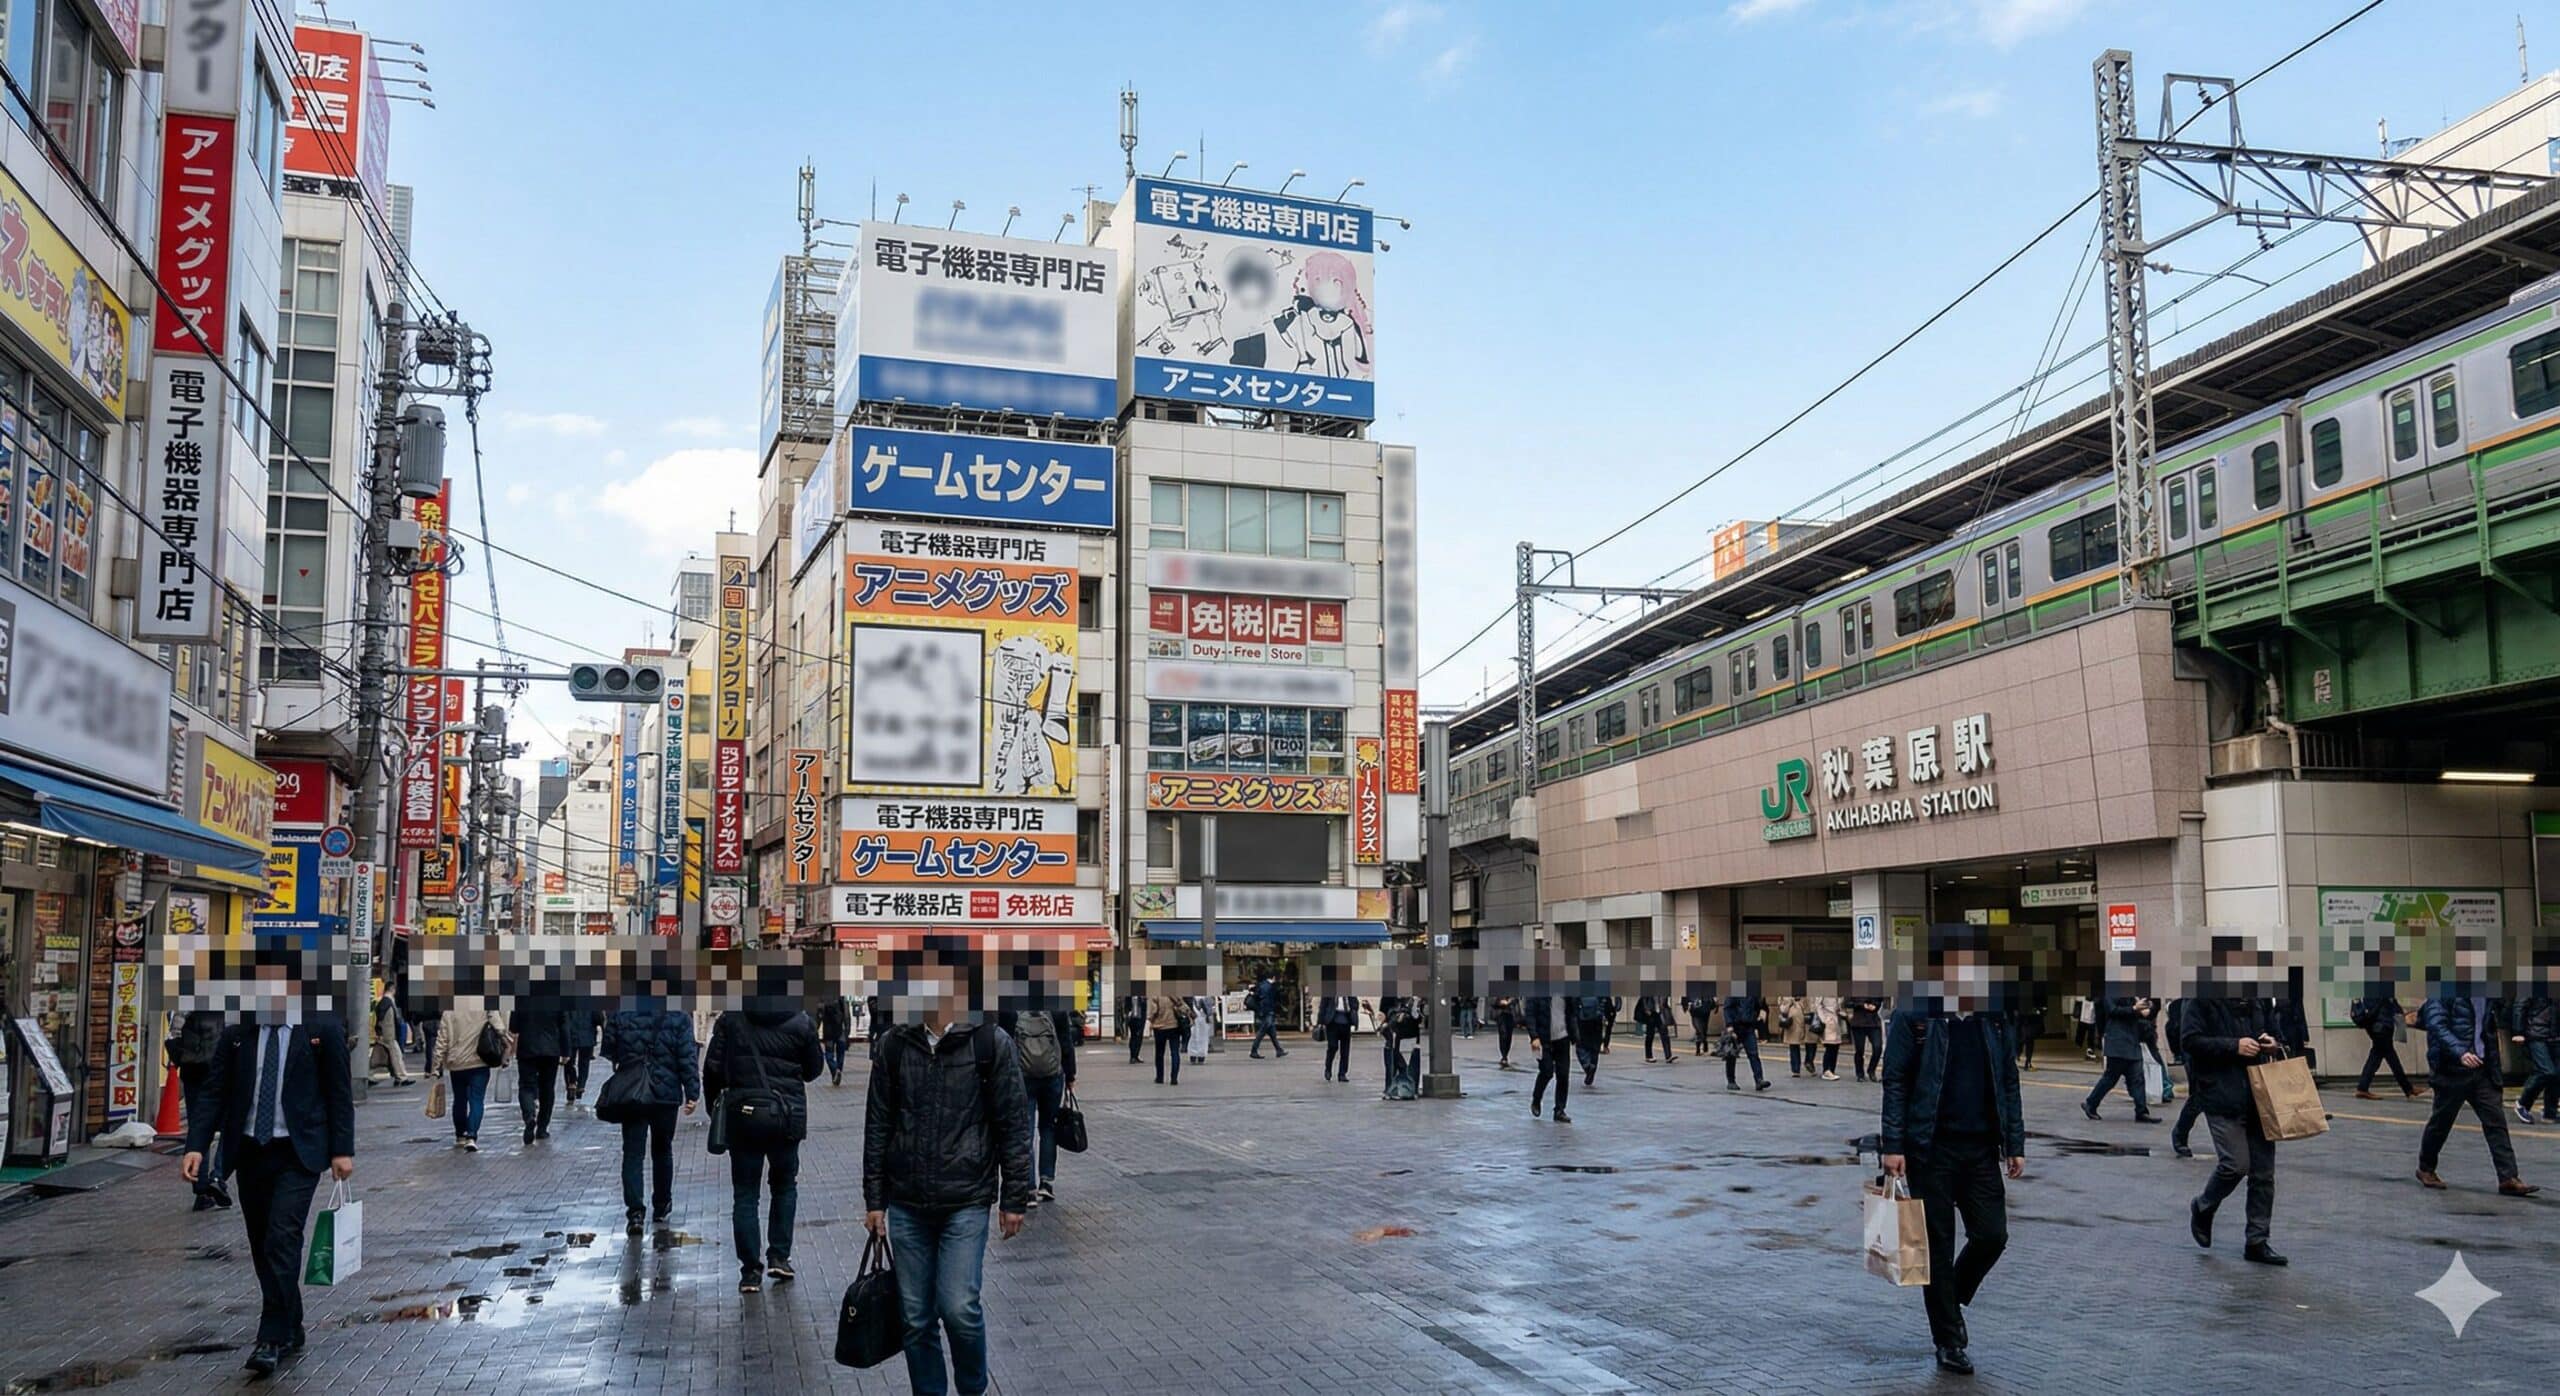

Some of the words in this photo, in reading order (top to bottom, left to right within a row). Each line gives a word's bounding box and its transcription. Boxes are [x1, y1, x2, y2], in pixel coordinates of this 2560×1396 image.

[172, 128, 218, 341] アニメグッズ
[1150, 187, 1360, 246] 電子機器専門店
[875, 237, 1106, 294] 電子機器専門店
[1162, 366, 1353, 407] アニメセンター
[156, 369, 206, 622] 電子機器専門店
[861, 444, 1106, 506] ゲームセンター
[879, 529, 1047, 562] 電子機器専門店
[854, 563, 1070, 617] アニメグッズ
[1191, 600, 1303, 640] 免税店
[1270, 647, 1303, 661] Store
[1822, 712, 1994, 800] 秋葉原駅
[1159, 775, 1324, 810] アニメグッズ
[1760, 756, 1813, 822] JR
[1826, 797, 1915, 831] AKIHABARA
[1920, 783, 1994, 818] STATION
[876, 804, 1045, 833] 電子機器専門店
[852, 836, 1069, 880] ゲームセンター
[844, 892, 964, 917] 電子機器店
[1005, 894, 1075, 918] 免税店
